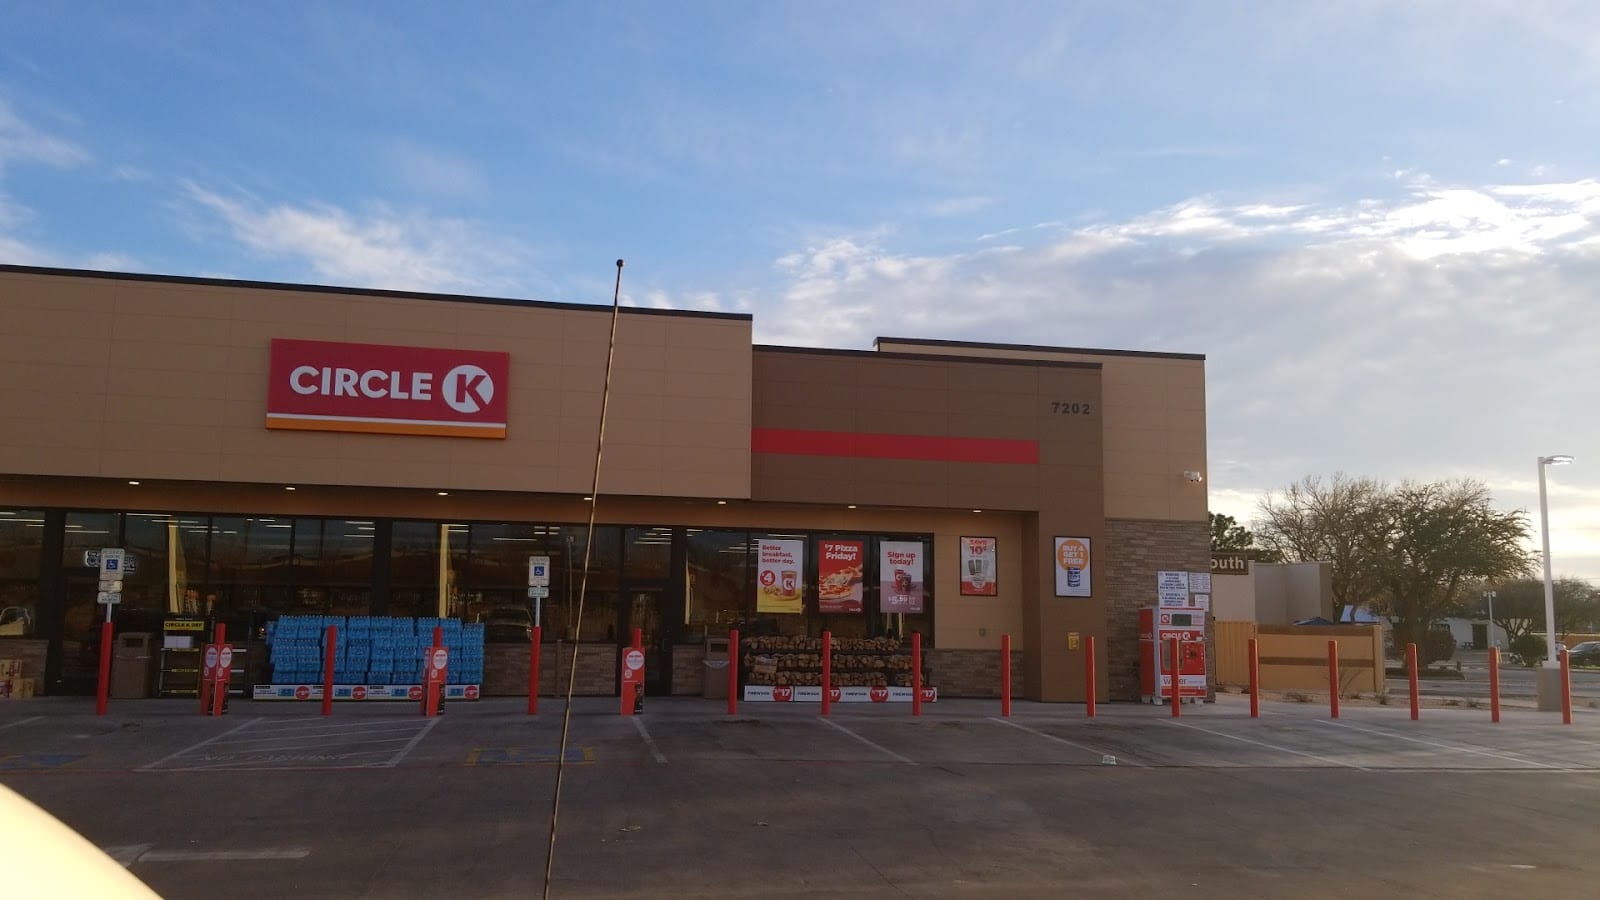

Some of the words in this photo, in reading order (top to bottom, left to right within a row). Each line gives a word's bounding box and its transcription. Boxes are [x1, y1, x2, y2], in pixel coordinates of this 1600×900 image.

[289, 365, 433, 401] CIRCLE
[453, 371, 490, 412] K
[1051, 401, 1090, 415] 7202
[834, 544, 858, 552] Pizza
[825, 552, 857, 561] Friday!
[887, 551, 905, 559] Sign
[889, 558, 914, 566] today!
[1210, 556, 1244, 569] outh
